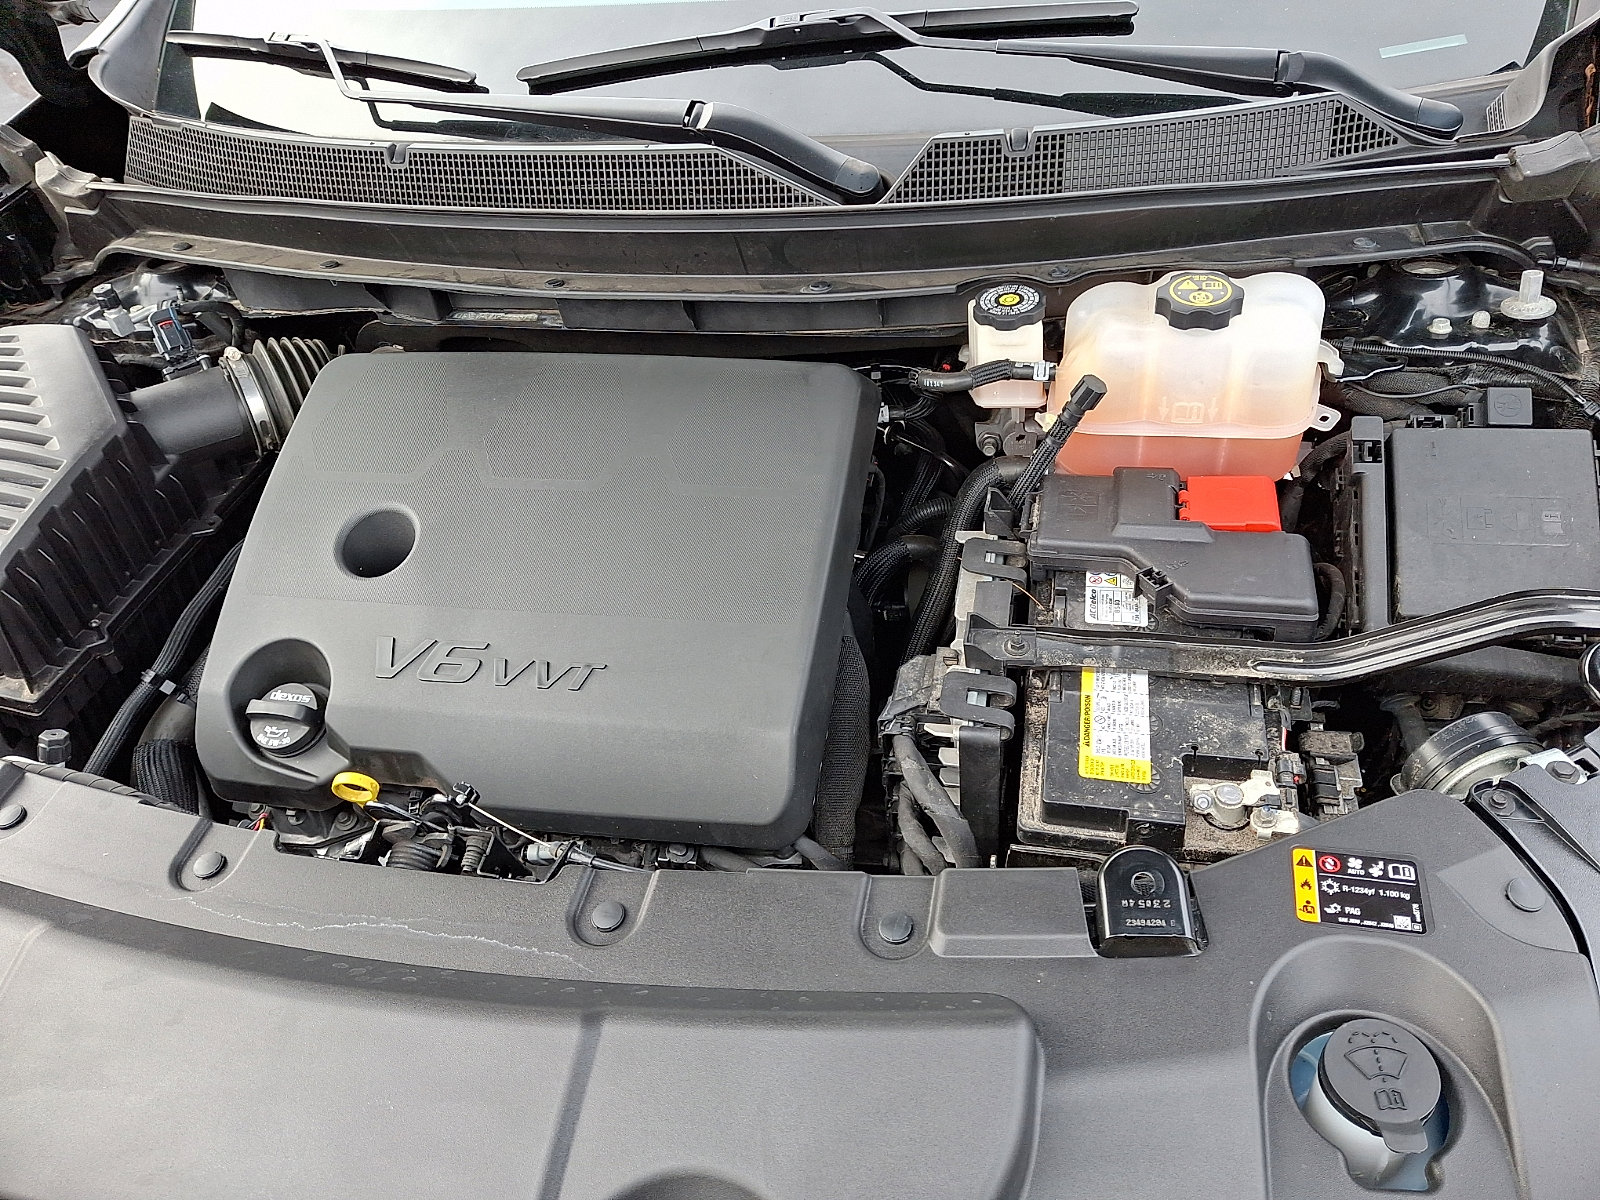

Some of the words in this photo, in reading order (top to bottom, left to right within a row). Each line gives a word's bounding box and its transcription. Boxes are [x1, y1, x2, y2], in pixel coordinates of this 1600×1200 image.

[375, 635, 490, 683] V6
[493, 657, 608, 691] VVT
[269, 689, 312, 703] dexos
[1347, 868, 1365, 876] AUTO
[1342, 884, 1376, 896] R-1234yf
[1378, 889, 1400, 898] 1.100
[1400, 891, 1411, 900] kg
[1344, 906, 1361, 916] PAG
